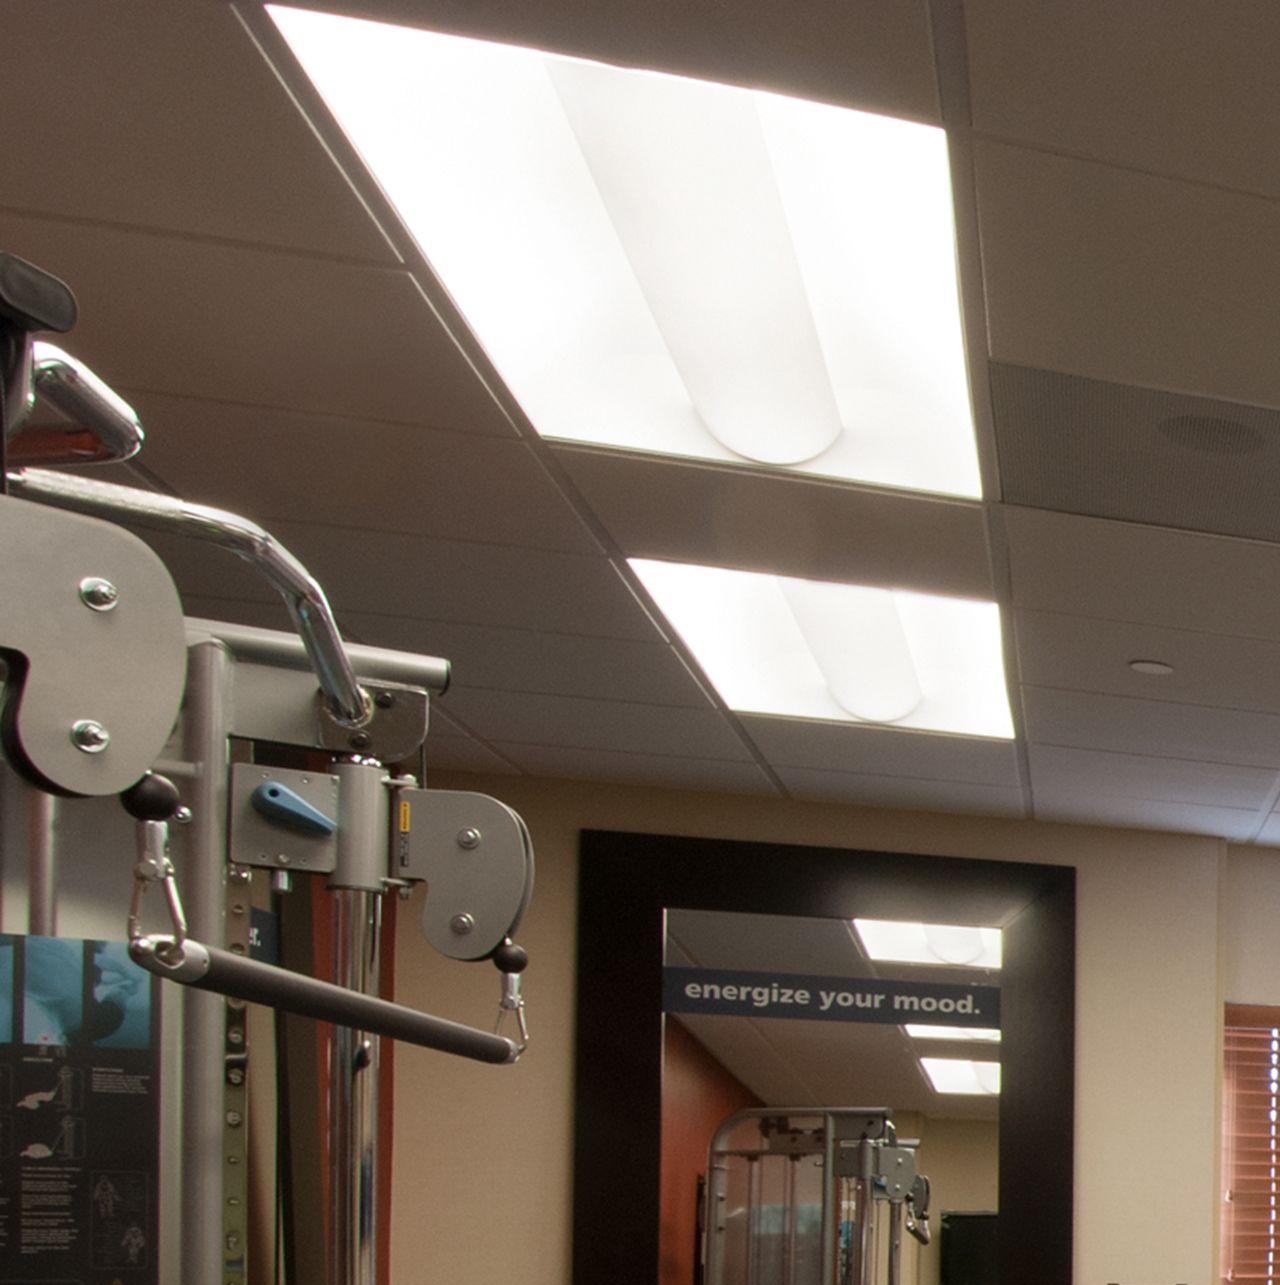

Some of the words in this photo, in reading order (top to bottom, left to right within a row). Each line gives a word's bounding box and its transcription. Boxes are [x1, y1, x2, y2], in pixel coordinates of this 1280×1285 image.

[684, 982, 810, 1007] energize
[818, 989, 885, 1011] your
[893, 994, 981, 1014] mood.
